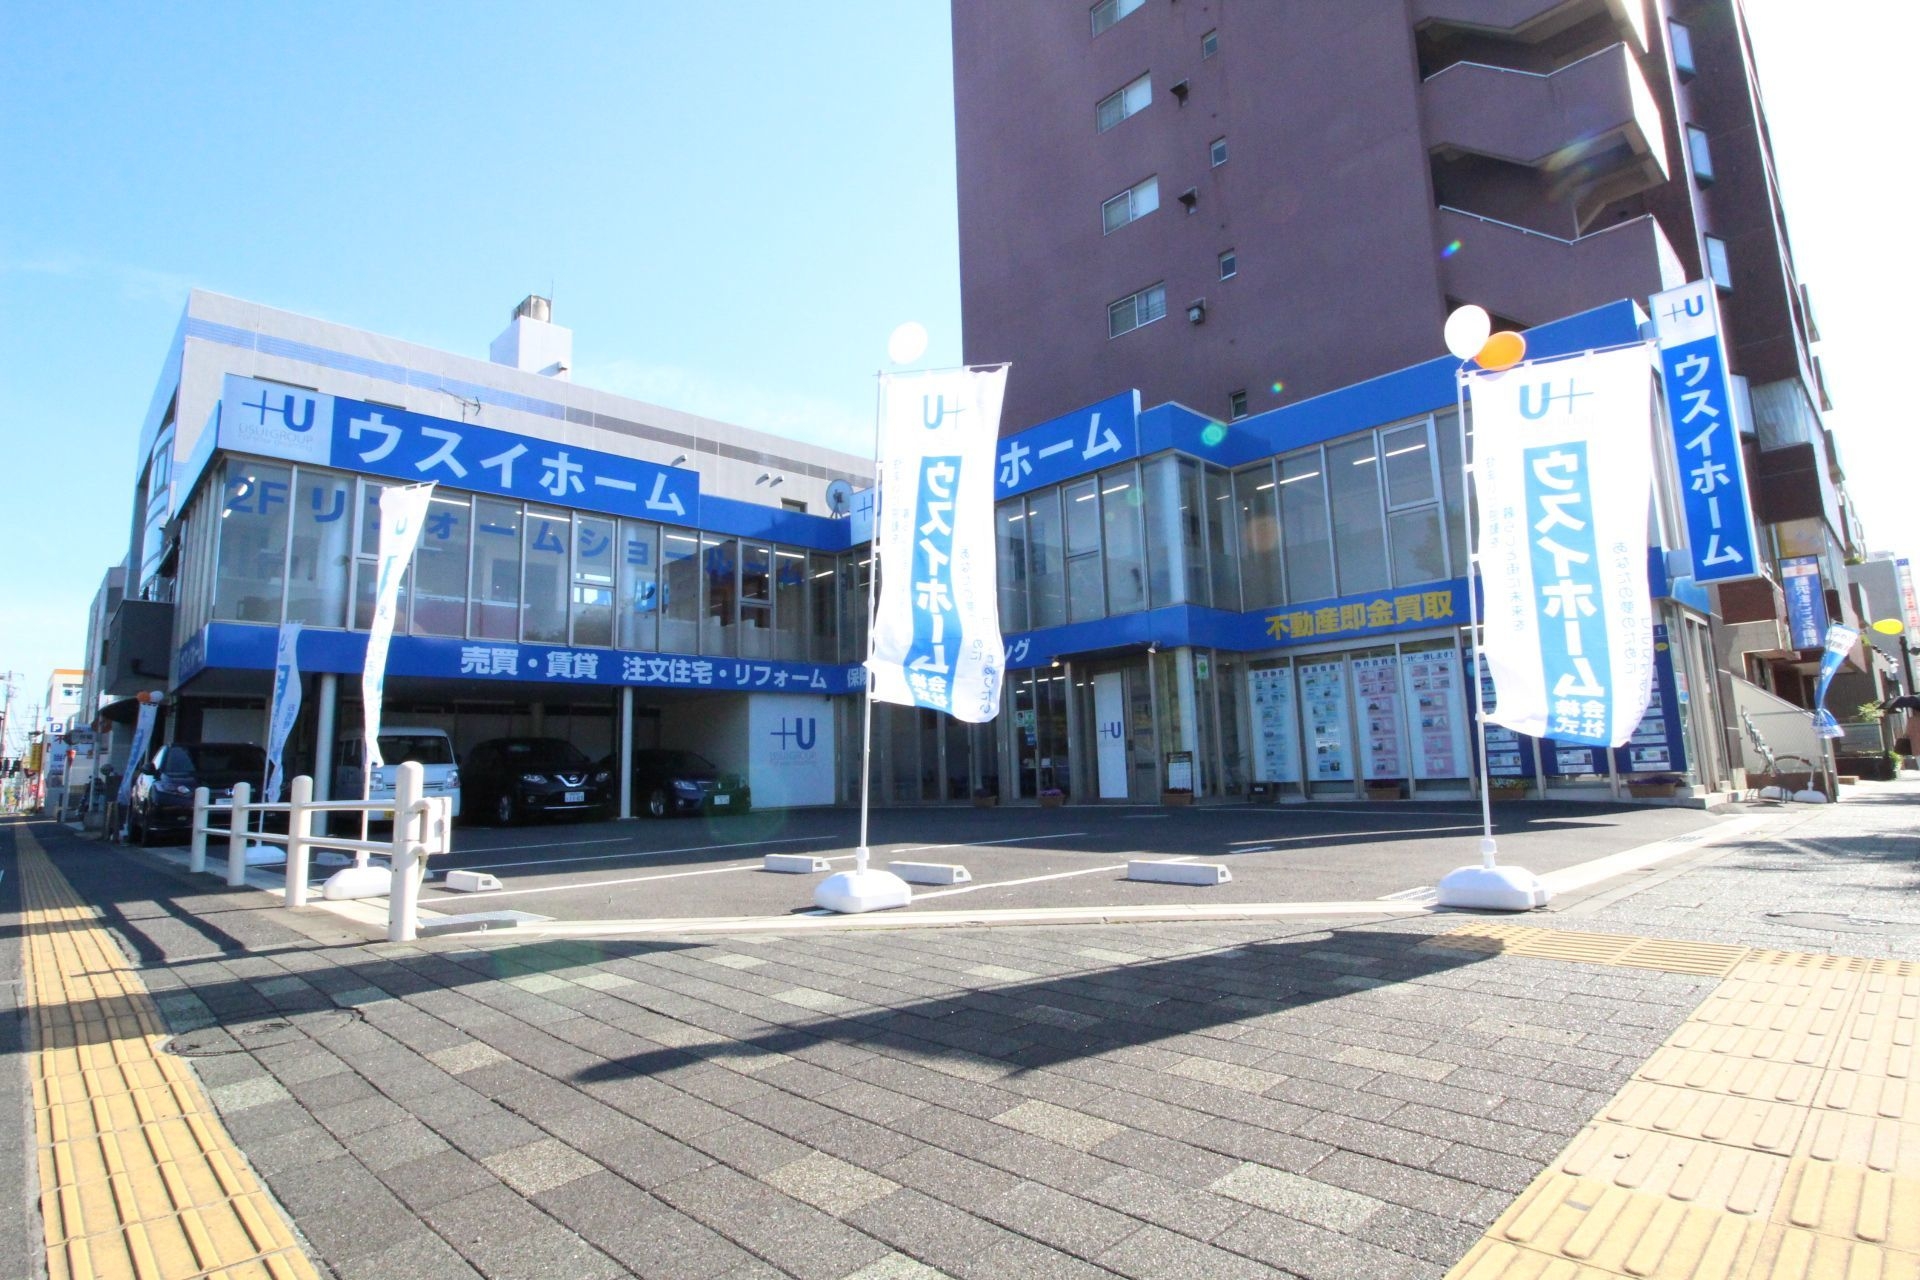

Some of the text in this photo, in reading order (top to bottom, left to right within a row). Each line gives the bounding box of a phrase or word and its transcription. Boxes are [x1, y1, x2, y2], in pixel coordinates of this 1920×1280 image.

[349, 412, 686, 516] ウスイホーム
[1675, 354, 1743, 567] ウスイホーム
[1265, 591, 1454, 641] 不動産即金買取
[460, 645, 599, 680] 売買・賃貸
[622, 656, 828, 689] 注文住宅・リフォーム
